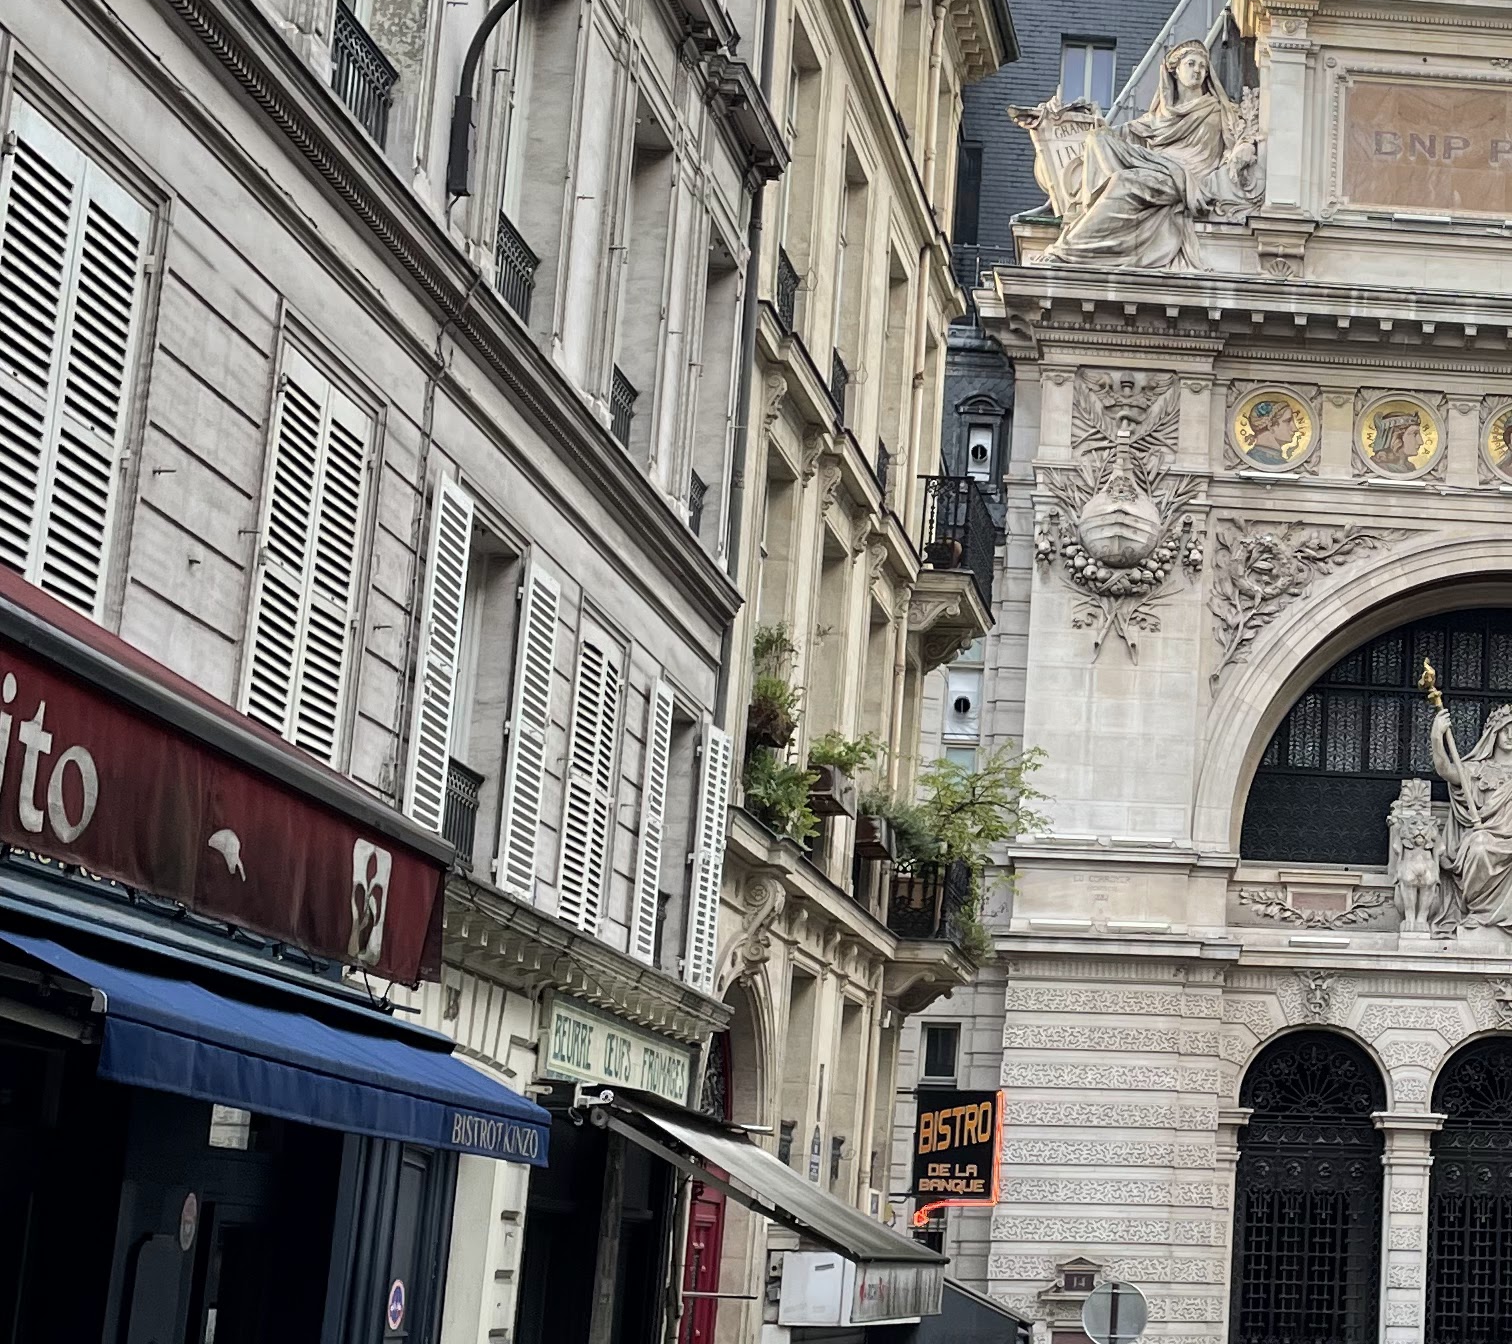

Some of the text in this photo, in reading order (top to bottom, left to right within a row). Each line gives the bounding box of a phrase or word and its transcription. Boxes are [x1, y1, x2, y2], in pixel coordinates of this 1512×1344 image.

[1373, 130, 1471, 160] BNP
[451, 1113, 539, 1159] BISTROT KINZO
[918, 1101, 992, 1155] BISTRO
[927, 1163, 978, 1177] DE LA
[918, 1178, 986, 1195] BANQUE
